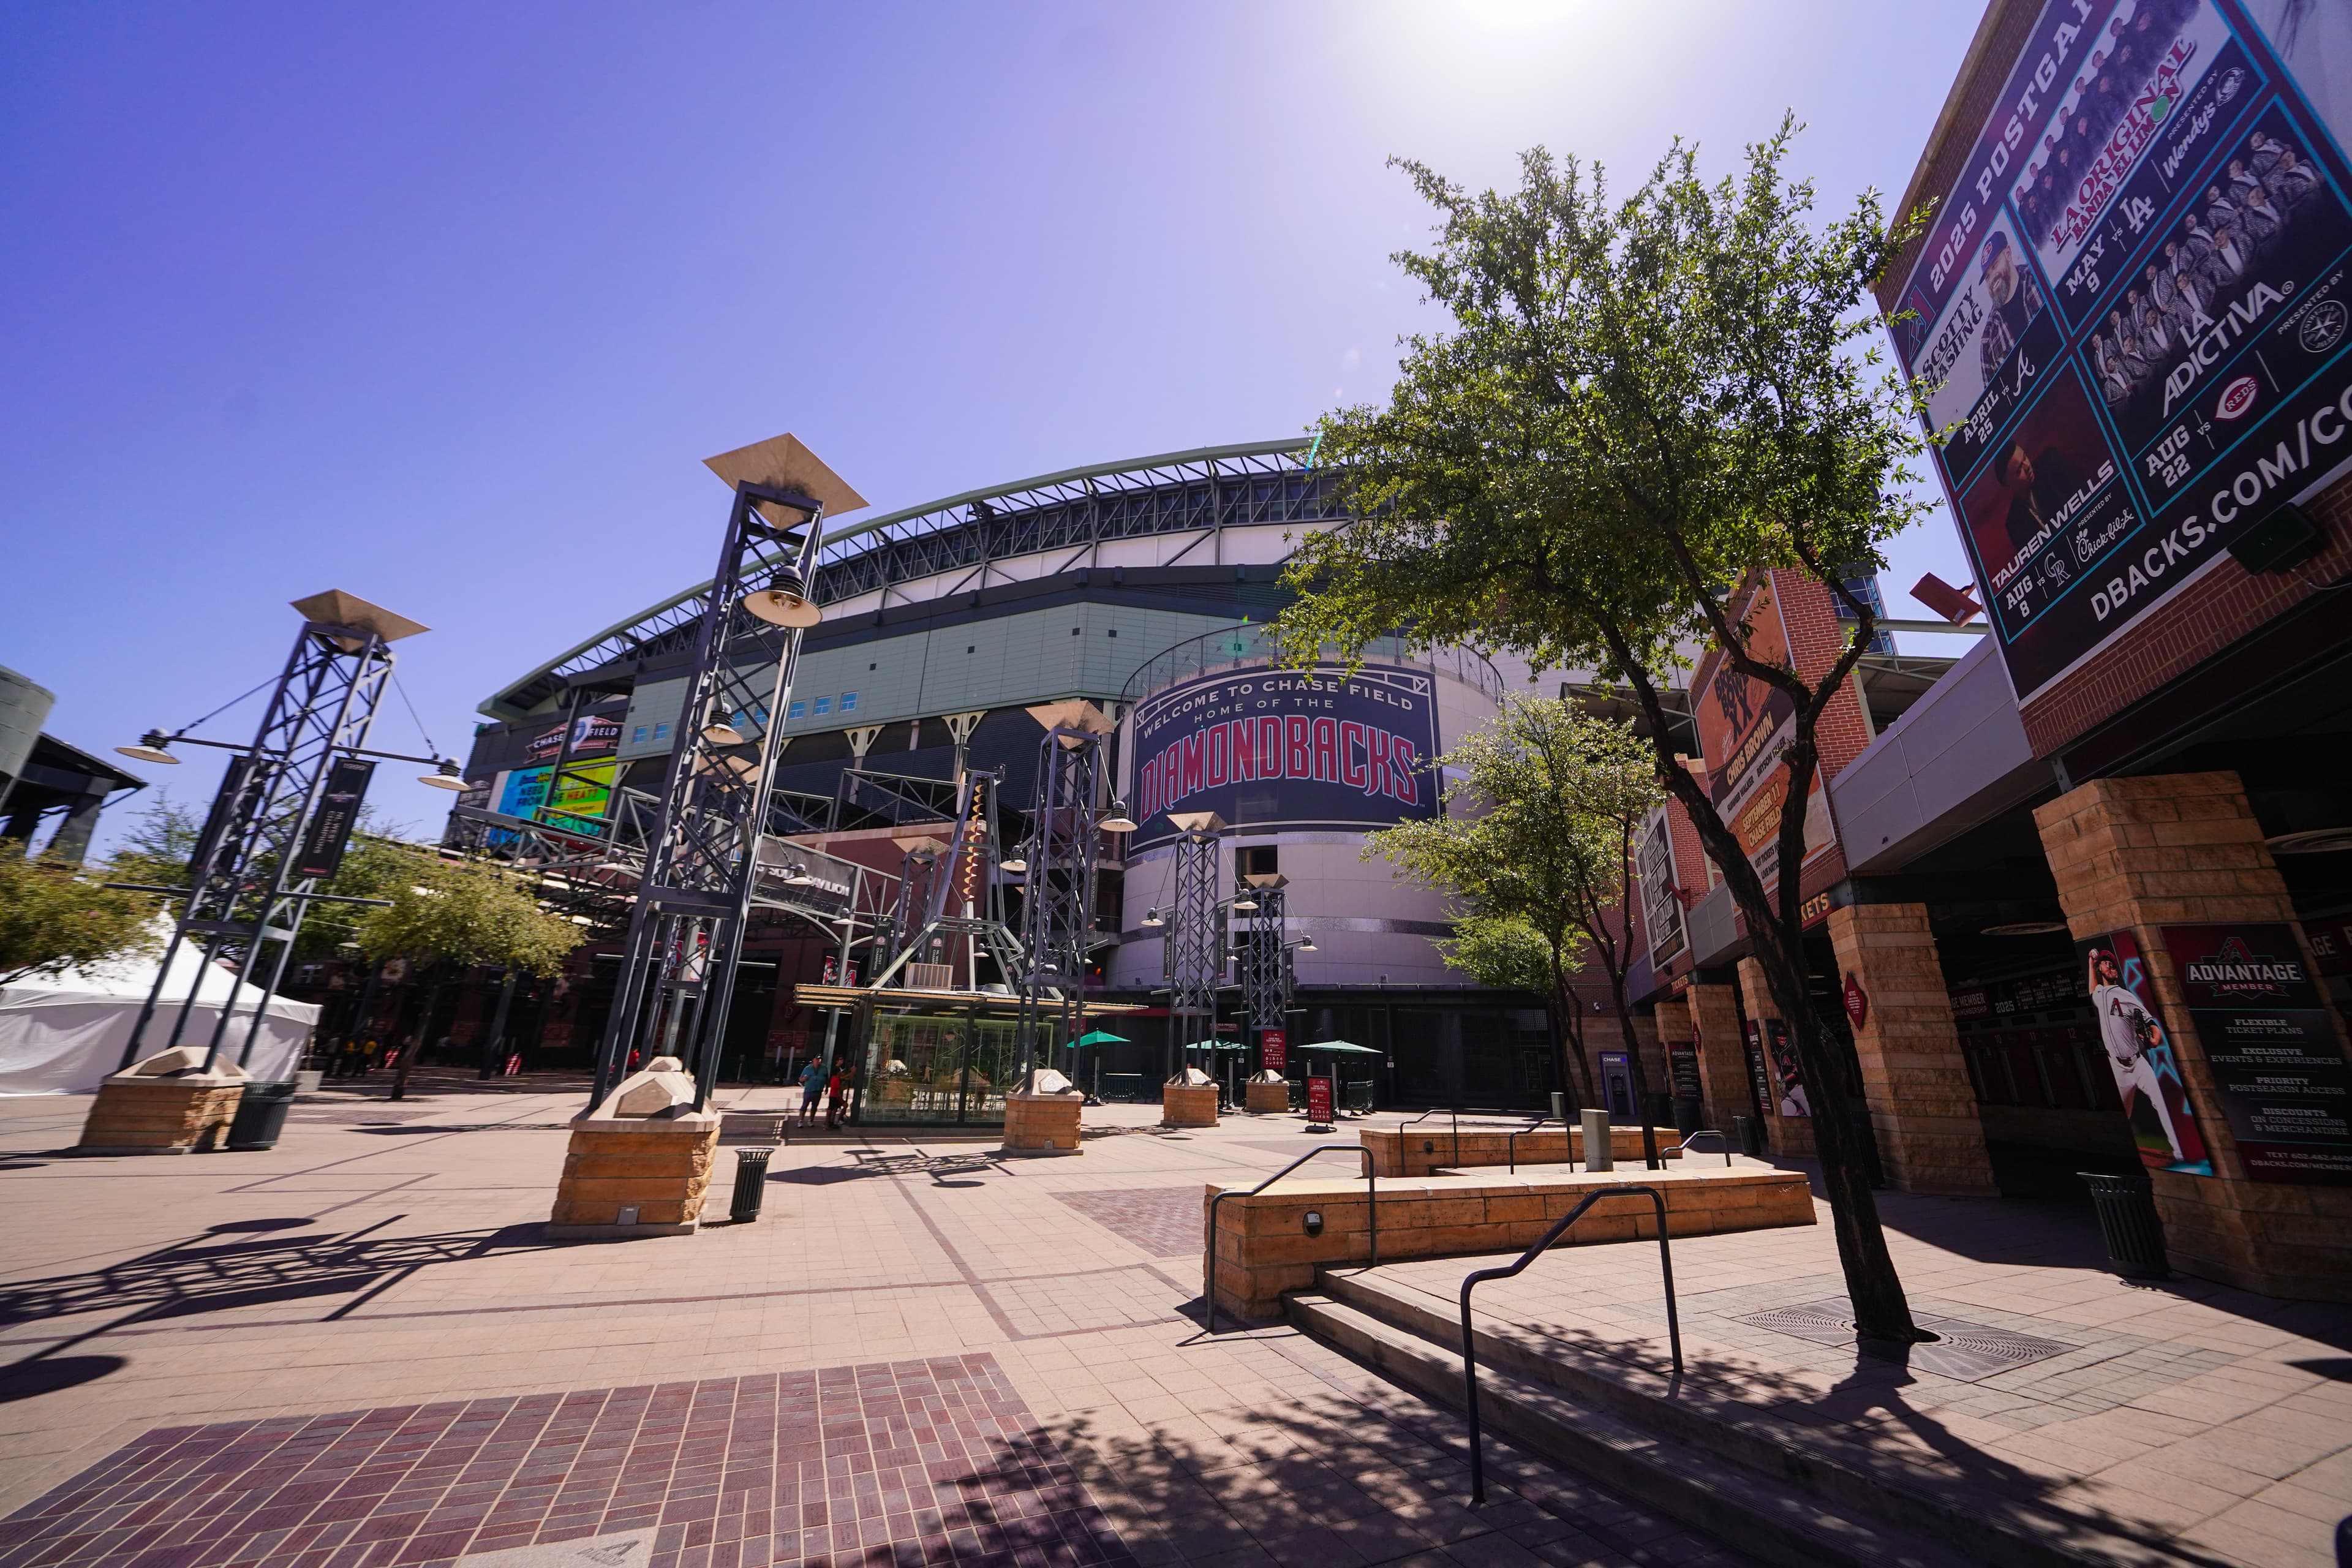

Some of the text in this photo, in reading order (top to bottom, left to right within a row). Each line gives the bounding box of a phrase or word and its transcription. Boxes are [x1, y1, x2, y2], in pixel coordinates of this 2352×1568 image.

[2168, 69, 2218, 141] PRESENTED BY
[2052, 39, 2194, 247] LA ORIGINAL
[2163, 101, 2216, 178] Wendy's
[2072, 179, 2114, 241] BANDA
[2111, 153, 2132, 180] EL
[1930, 201, 1977, 293] 2025
[2065, 234, 2106, 296] MAY
[2086, 276, 2101, 293] 9
[2277, 270, 2343, 335] PRESENTED BY
[1923, 285, 1975, 381] SCOTTY
[2179, 311, 2215, 349] LA
[2225, 379, 2256, 411] REDS
[1963, 390, 1999, 445] APRIL
[1978, 420, 1994, 445] 25
[2146, 424, 2190, 477] AUG
[2162, 453, 2192, 489] 22
[1992, 459, 2114, 589] TAUREN WELLS
[2077, 492, 2113, 529] PRESENTED BY
[2005, 575, 2034, 610] AUG
[2019, 600, 2030, 618] 8
[1144, 680, 1413, 739] WELCOME TO CHASE FIELD
[1194, 698, 1334, 724] HOME OF THE
[533, 727, 618, 748] CHASE FIELD
[1727, 750, 1745, 786] CHRIS
[1744, 710, 1774, 760] BROWN
[1139, 714, 1419, 827] DIAMONDBACKS
[514, 796, 544, 807] FROM
[567, 788, 598, 802] HEAT?
[520, 785, 545, 796] NEED
[1727, 775, 1754, 813] SUMMER WALKER
[1743, 780, 1781, 834] SEPTEMBER 11
[1749, 805, 1781, 848] CHASE FIELD
[1762, 844, 1776, 864] TICKETS
[1800, 891, 1831, 923] KETS
[1672, 974, 1689, 992] TICKETS
[2188, 964, 2302, 981] ADVANTAGE
[1994, 1000, 2016, 1014] 2025
[2224, 1026, 2264, 1035] TICKET
[2210, 1054, 2254, 1063] EVENTS
[2266, 1055, 2343, 1065] EXPERIENCES
[2228, 1084, 2347, 1095] POSTSEASON ACCESS
[2254, 1077, 2311, 1085] PRIORITY
[2261, 1107, 2329, 1118] DISCOUNTS
[2267, 1116, 2347, 1127] CONCESSIONS
[2266, 1125, 2351, 1136] MERCHANDISE
